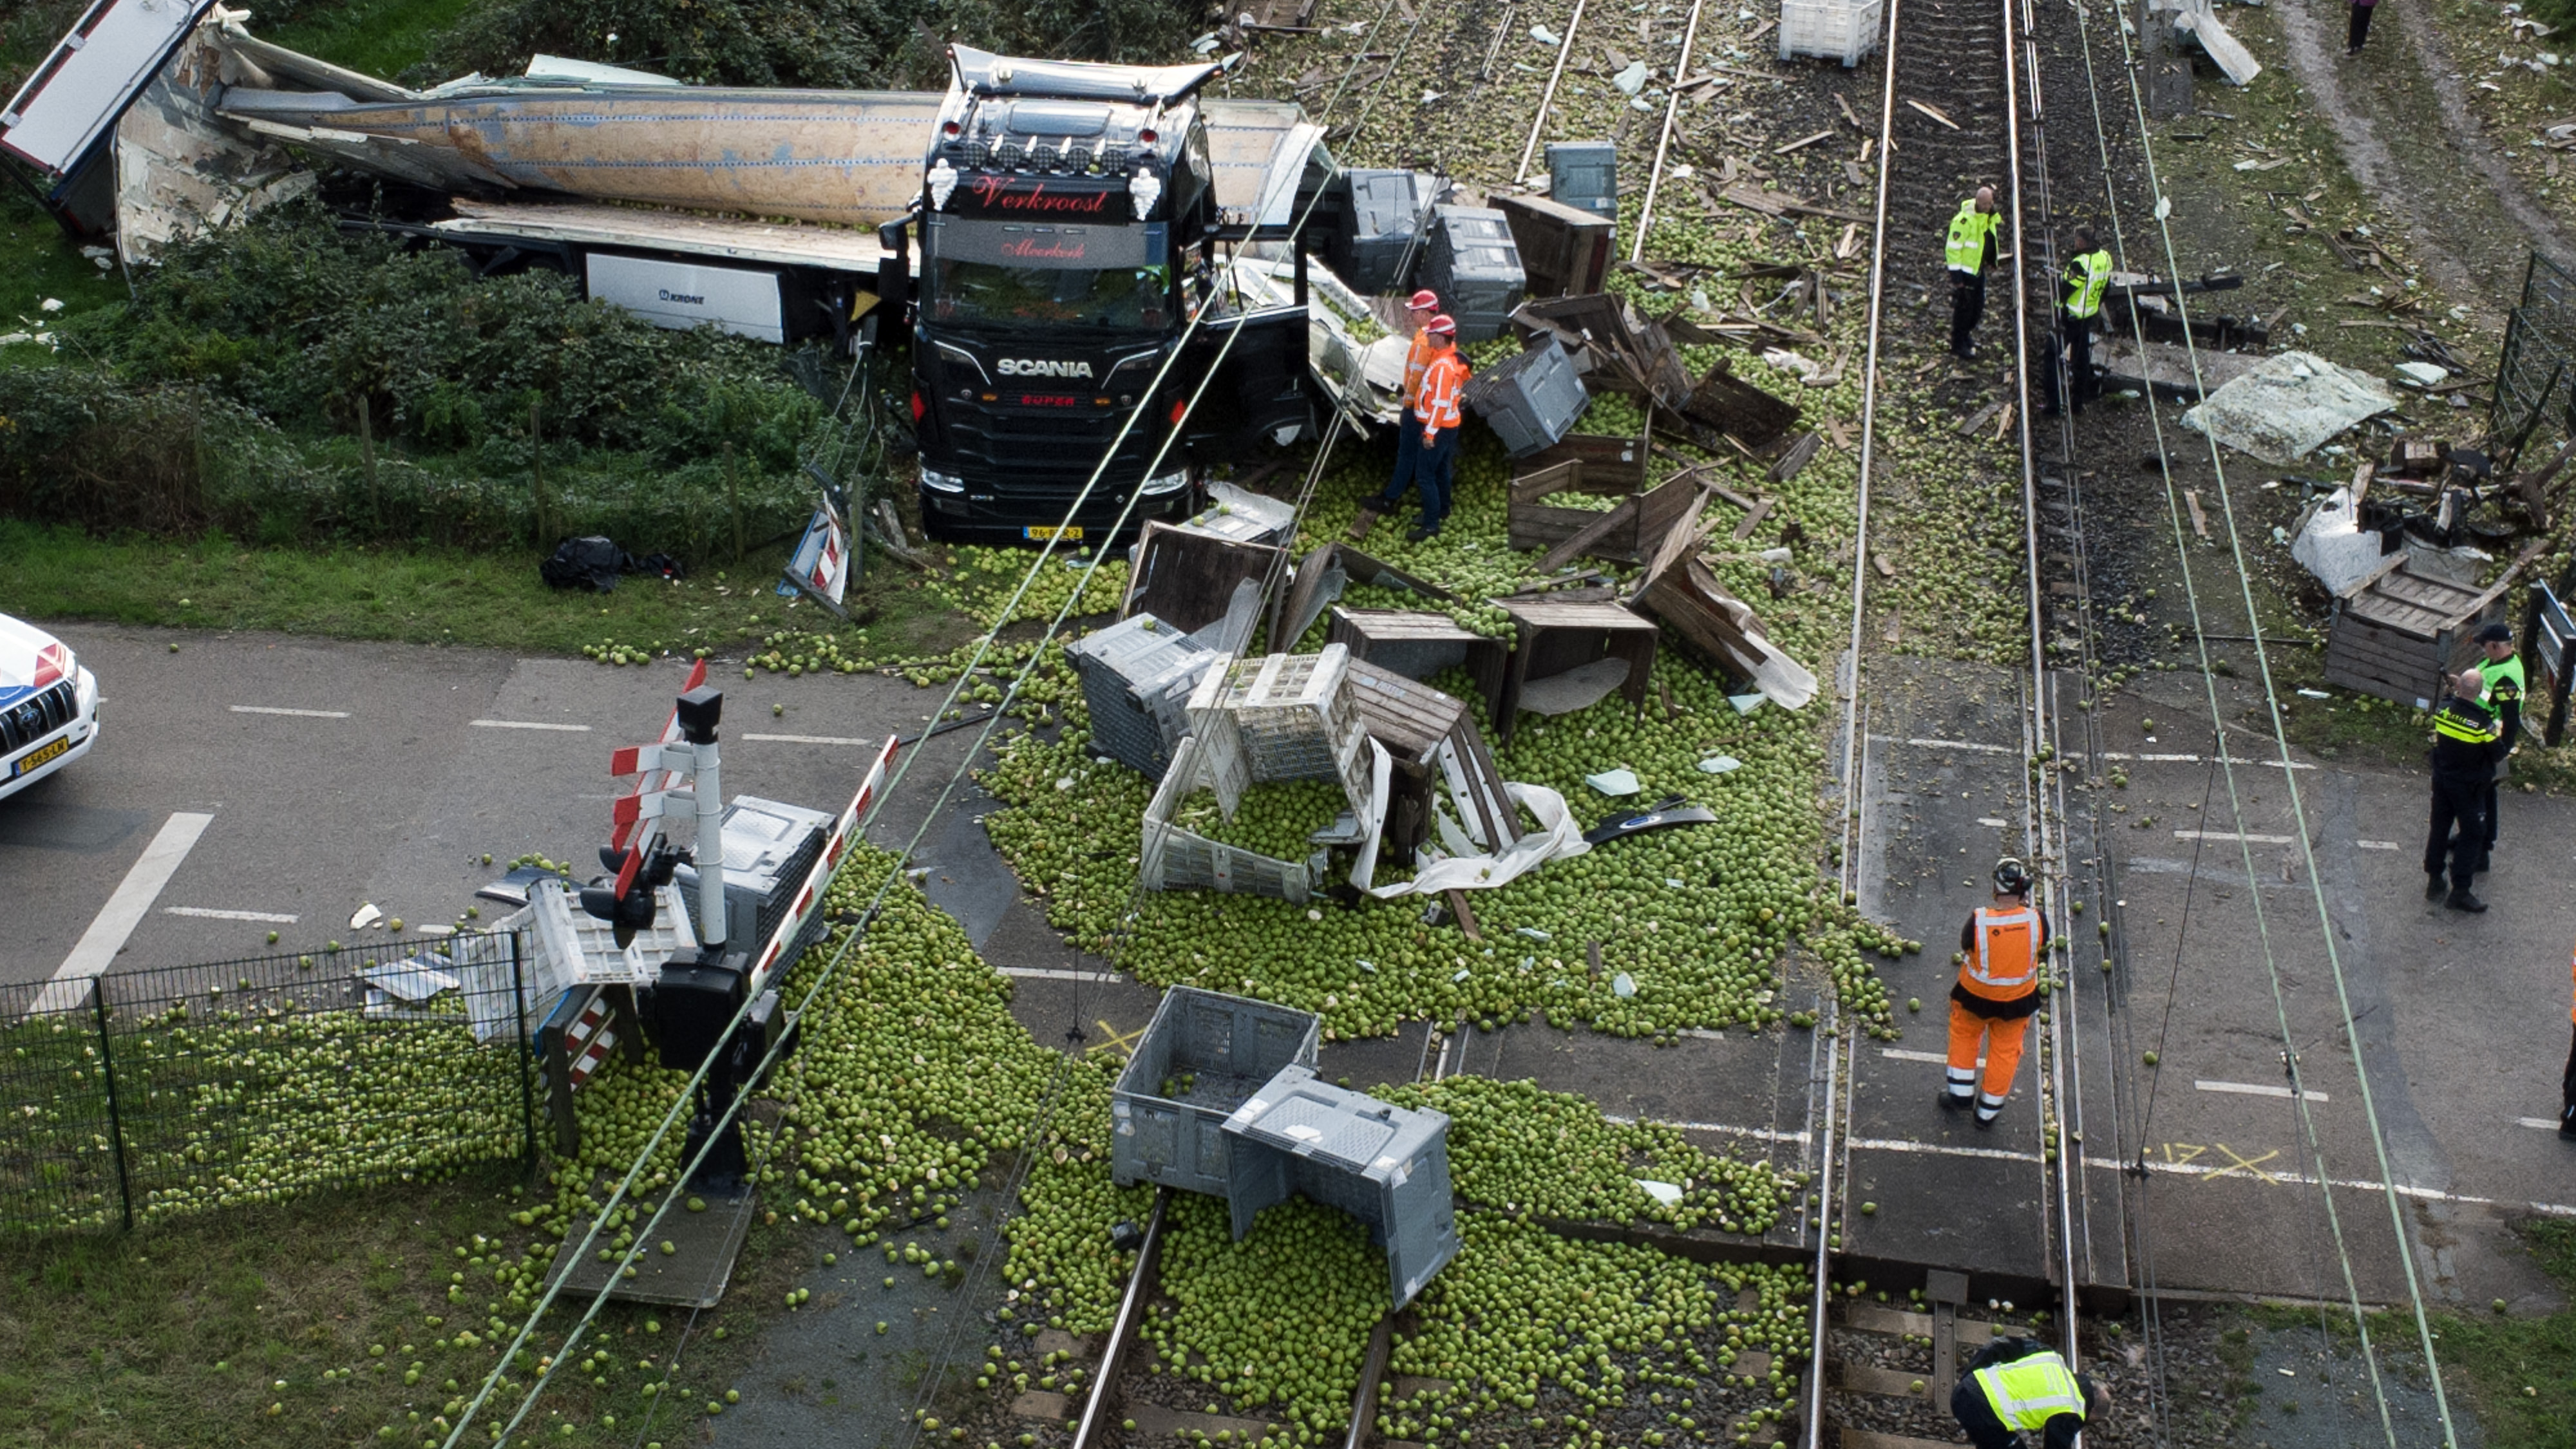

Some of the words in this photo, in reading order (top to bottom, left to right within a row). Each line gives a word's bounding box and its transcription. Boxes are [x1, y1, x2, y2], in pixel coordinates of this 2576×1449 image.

[972, 175, 1107, 212] Verkroost
[670, 294, 705, 305] KRONE
[998, 359, 1093, 378] SCANIA
[1021, 394, 1075, 406] SUPER
